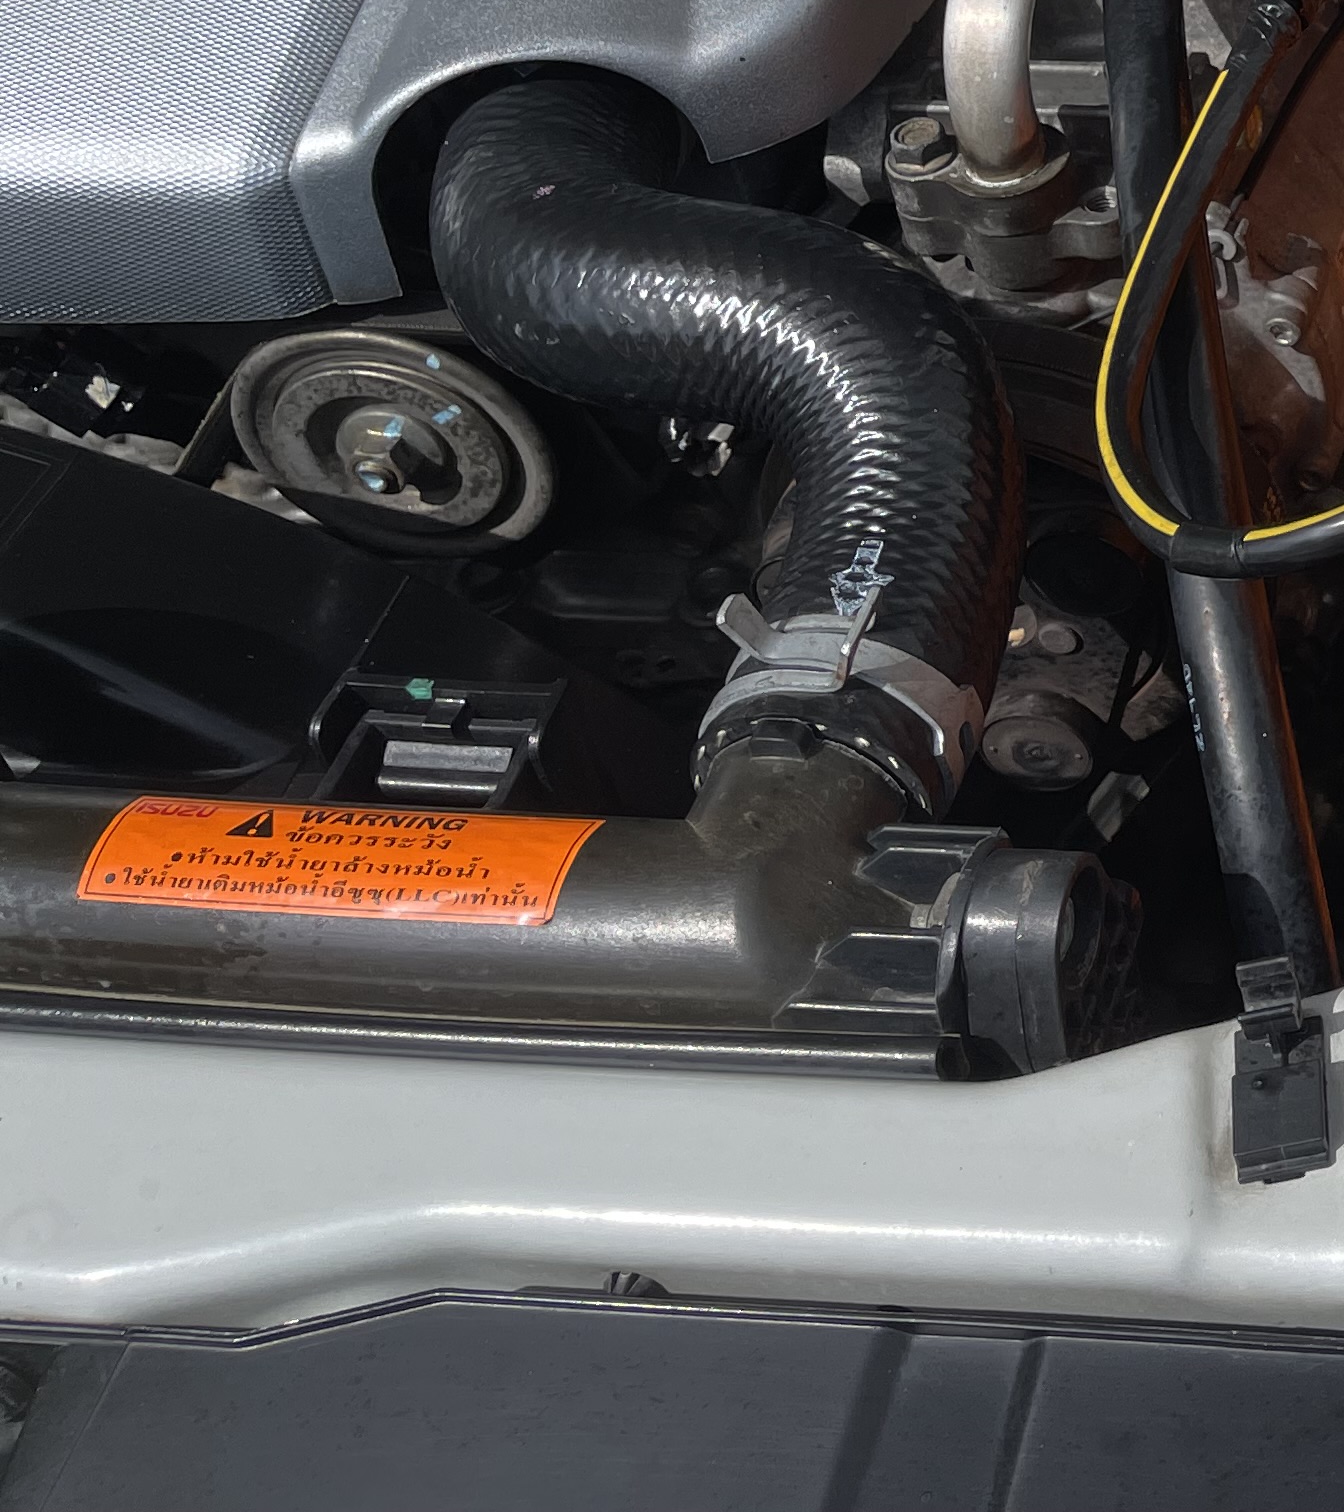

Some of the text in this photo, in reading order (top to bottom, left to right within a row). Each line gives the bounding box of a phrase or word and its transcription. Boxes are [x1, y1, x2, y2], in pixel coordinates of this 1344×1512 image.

[135, 802, 220, 819] ISUZU
[300, 809, 469, 832] WARNING
[285, 825, 453, 851] ข้อควรระวัง
